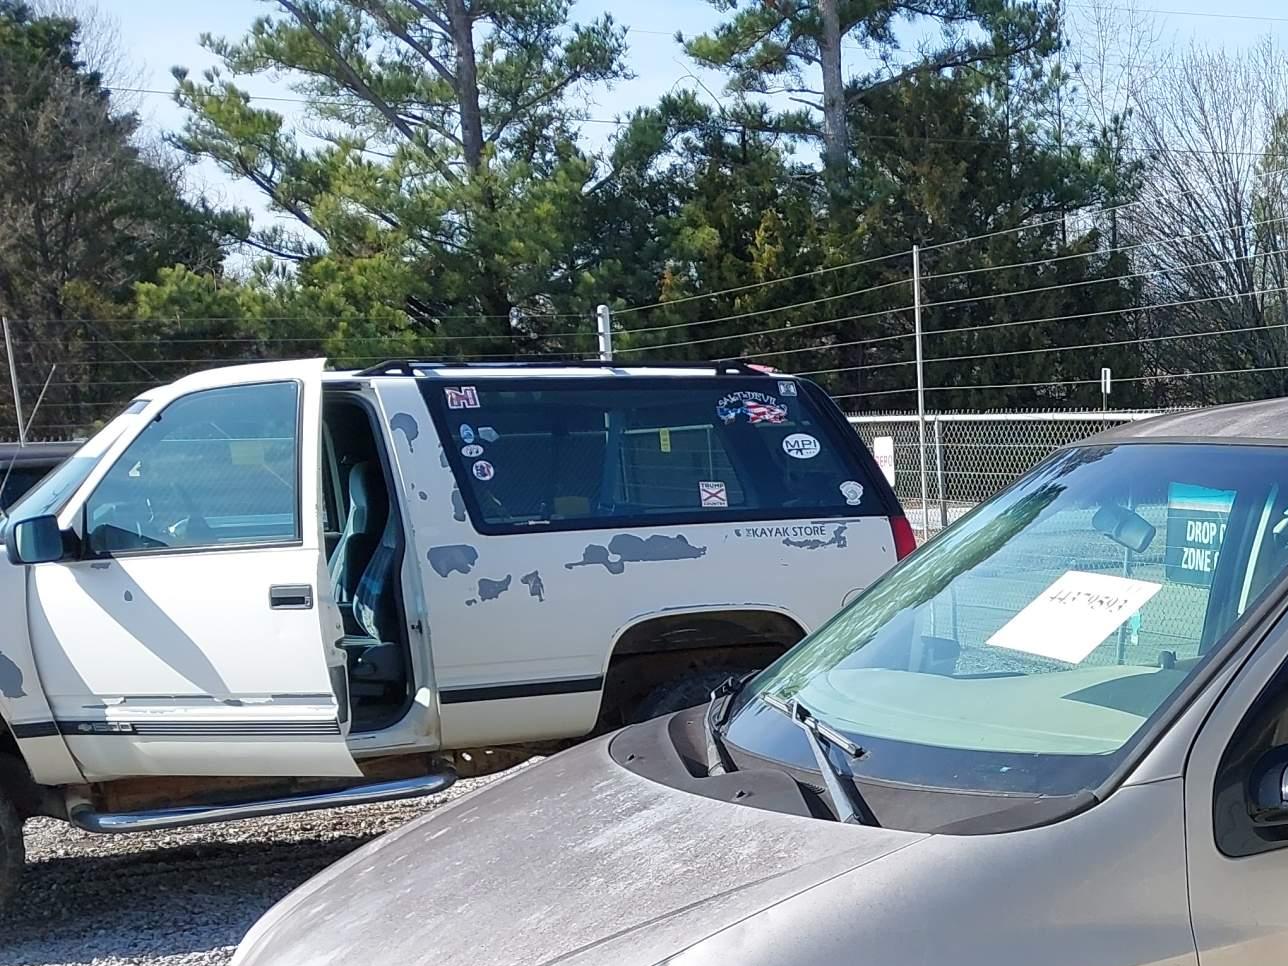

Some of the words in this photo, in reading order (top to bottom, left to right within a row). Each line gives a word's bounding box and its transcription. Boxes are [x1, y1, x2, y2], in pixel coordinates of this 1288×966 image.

[785, 439, 817, 449] MPI
[752, 526, 790, 538] KAYAK
[790, 525, 826, 537] STORE
[1186, 520, 1217, 545] DROP
[1181, 547, 1212, 572] ZONE
